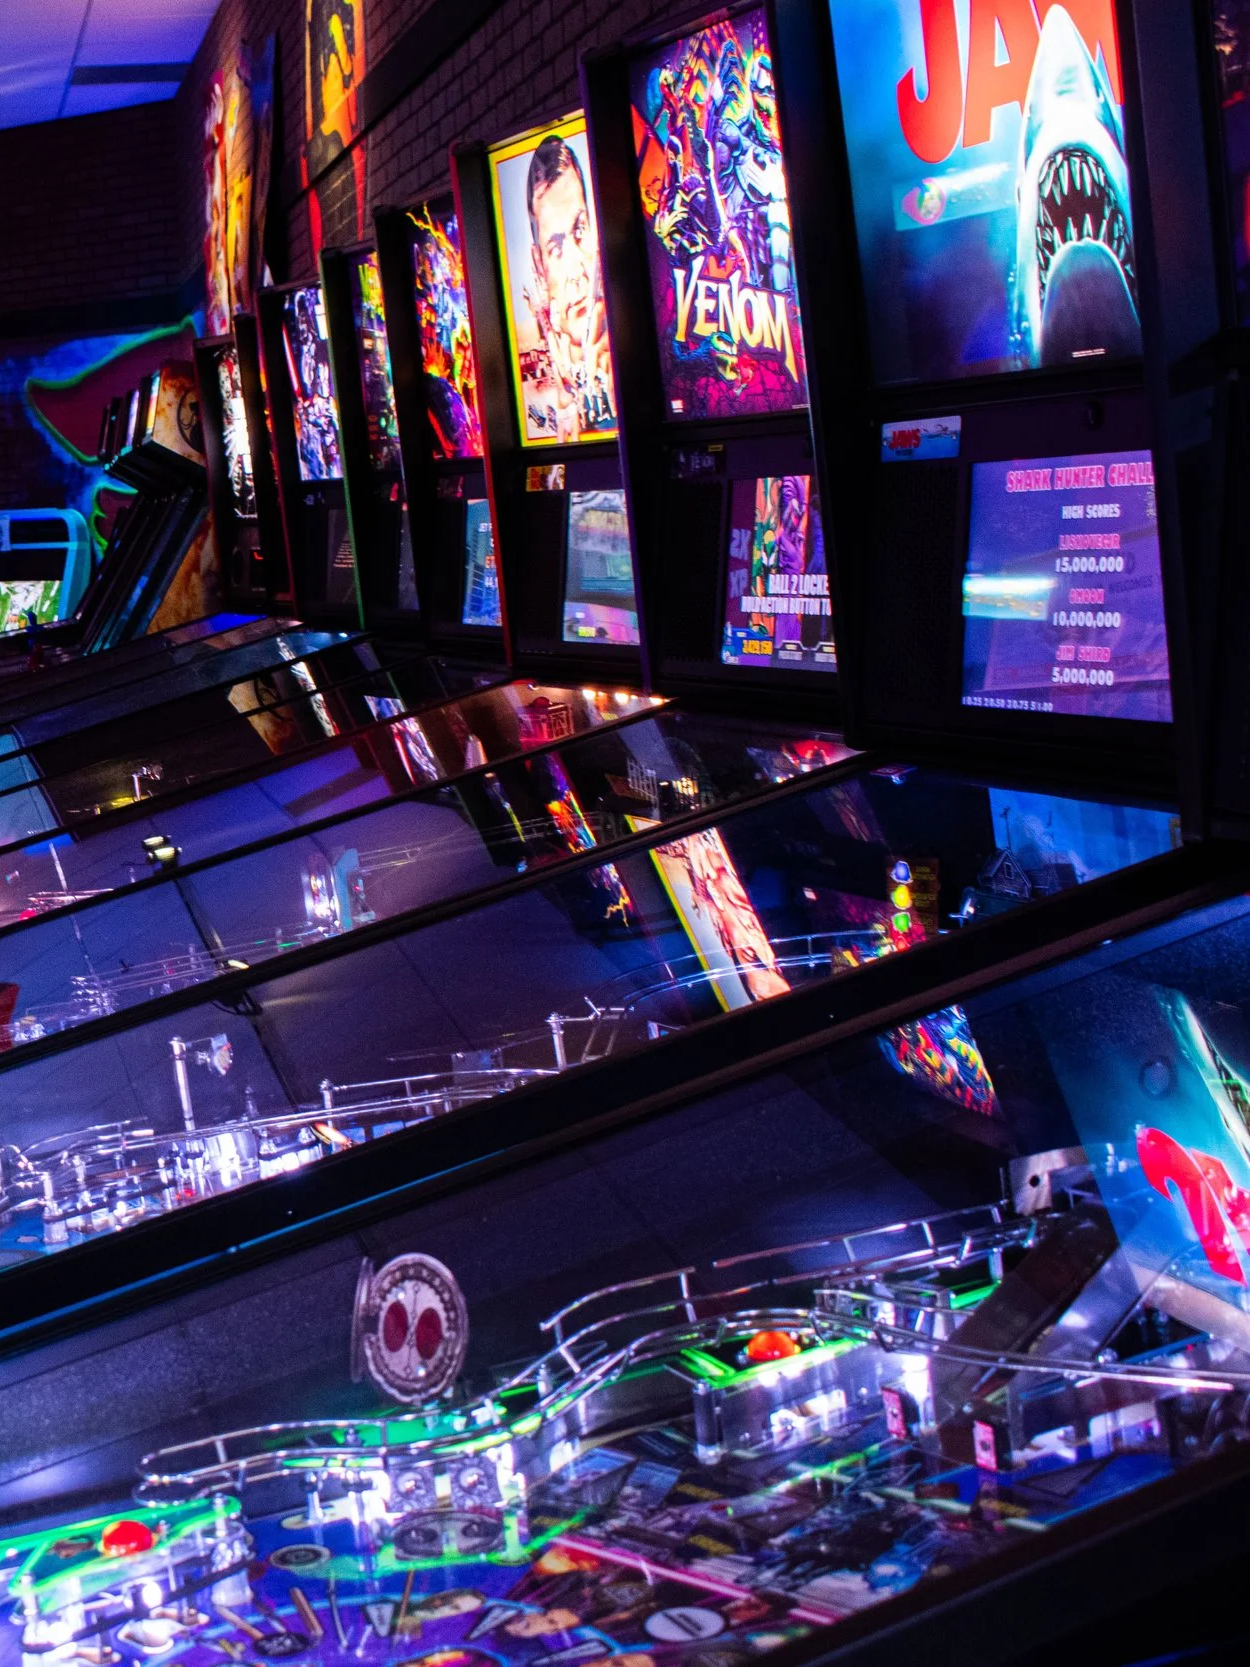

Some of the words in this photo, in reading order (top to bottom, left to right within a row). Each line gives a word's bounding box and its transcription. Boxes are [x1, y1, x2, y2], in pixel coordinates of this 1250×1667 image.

[673, 255, 799, 383] VENOM
[889, 428, 921, 450] JAWS
[1006, 468, 1052, 493] SHARK
[1054, 465, 1106, 490] HUNTER
[1061, 505, 1084, 520] HIGH
[1086, 503, 1121, 519] SCORES
[1055, 556, 1124, 574] 15,000,000
[768, 574, 789, 595] BALL
[790, 574, 798, 595] 2
[1052, 611, 1121, 628] 10,000,000
[1052, 667, 1114, 687] 5,000,000
